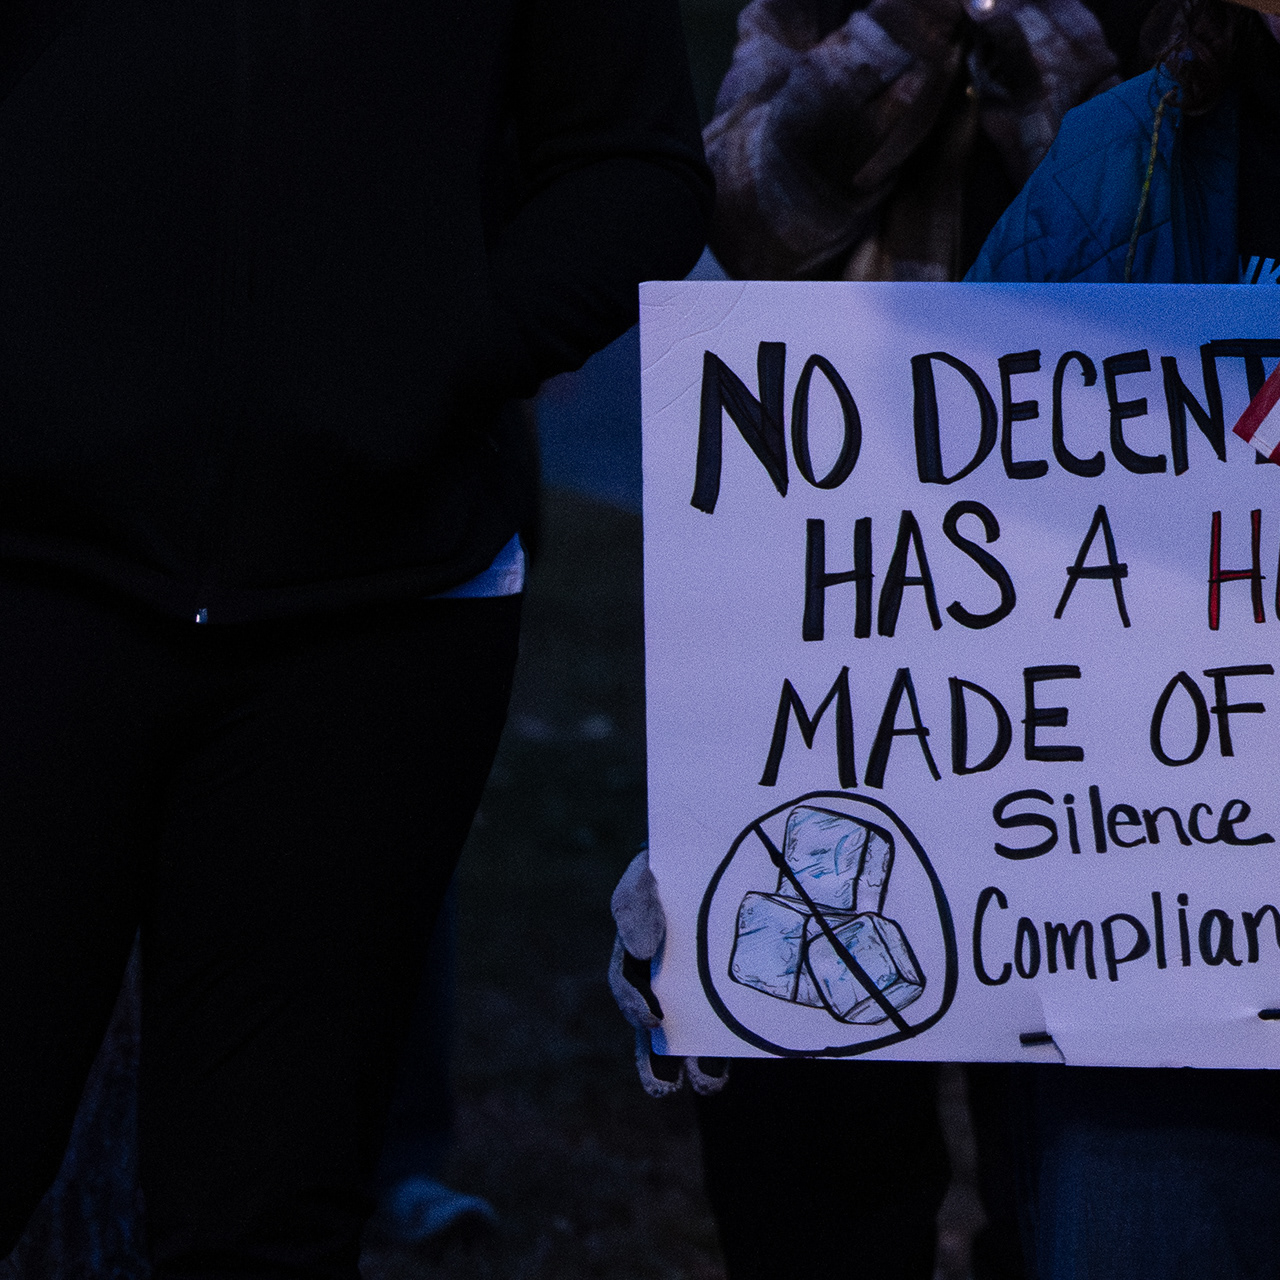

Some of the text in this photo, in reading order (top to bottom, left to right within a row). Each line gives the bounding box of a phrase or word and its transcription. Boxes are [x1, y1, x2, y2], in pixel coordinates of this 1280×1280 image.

[690, 341, 862, 514] NO
[803, 500, 1016, 641] HAS
[1053, 504, 1131, 628] A
[758, 665, 1084, 789] MADE
[1149, 664, 1275, 767] OF
[992, 785, 1276, 860] Silence
